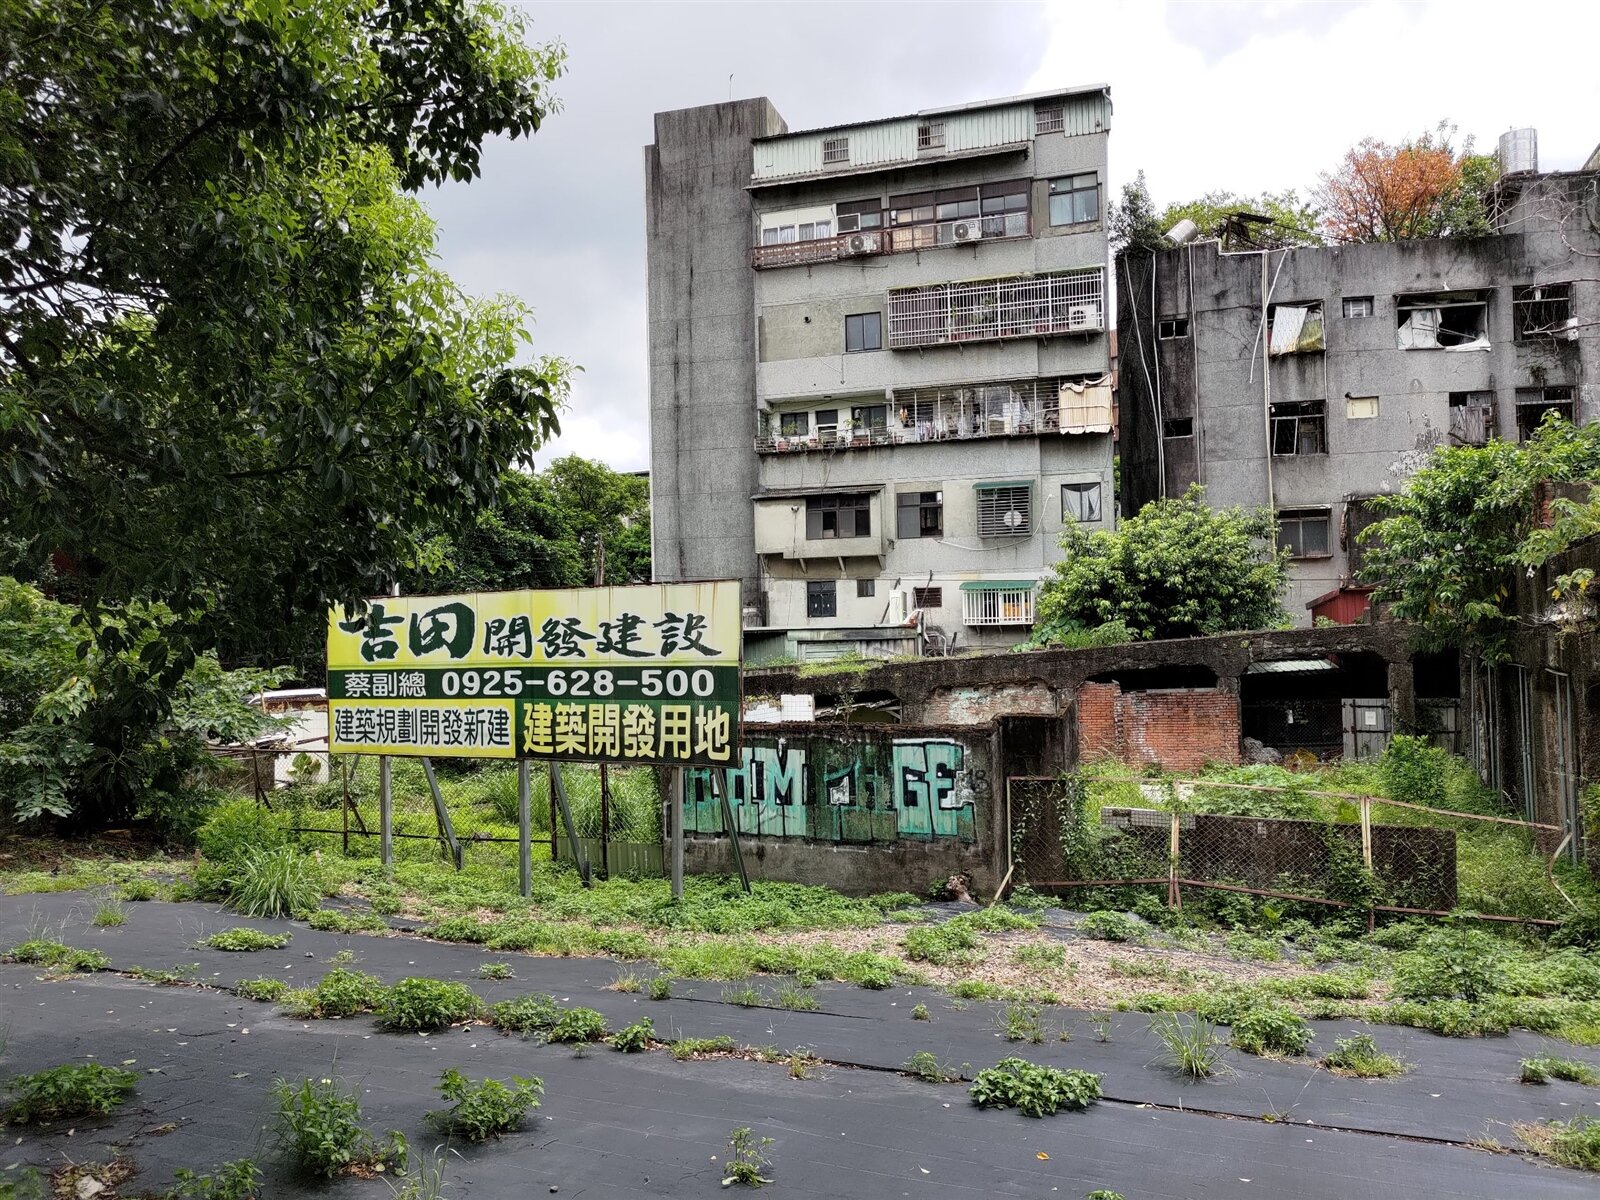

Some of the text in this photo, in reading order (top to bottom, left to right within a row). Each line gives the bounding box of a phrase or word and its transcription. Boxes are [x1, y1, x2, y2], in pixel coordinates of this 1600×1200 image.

[339, 602, 722, 662] 吉田開發建設
[344, 669, 714, 697] 蔡副總 0925-628-500
[334, 708, 510, 746] 建築規劃開發新建
[523, 702, 731, 761] 建築開發用地
